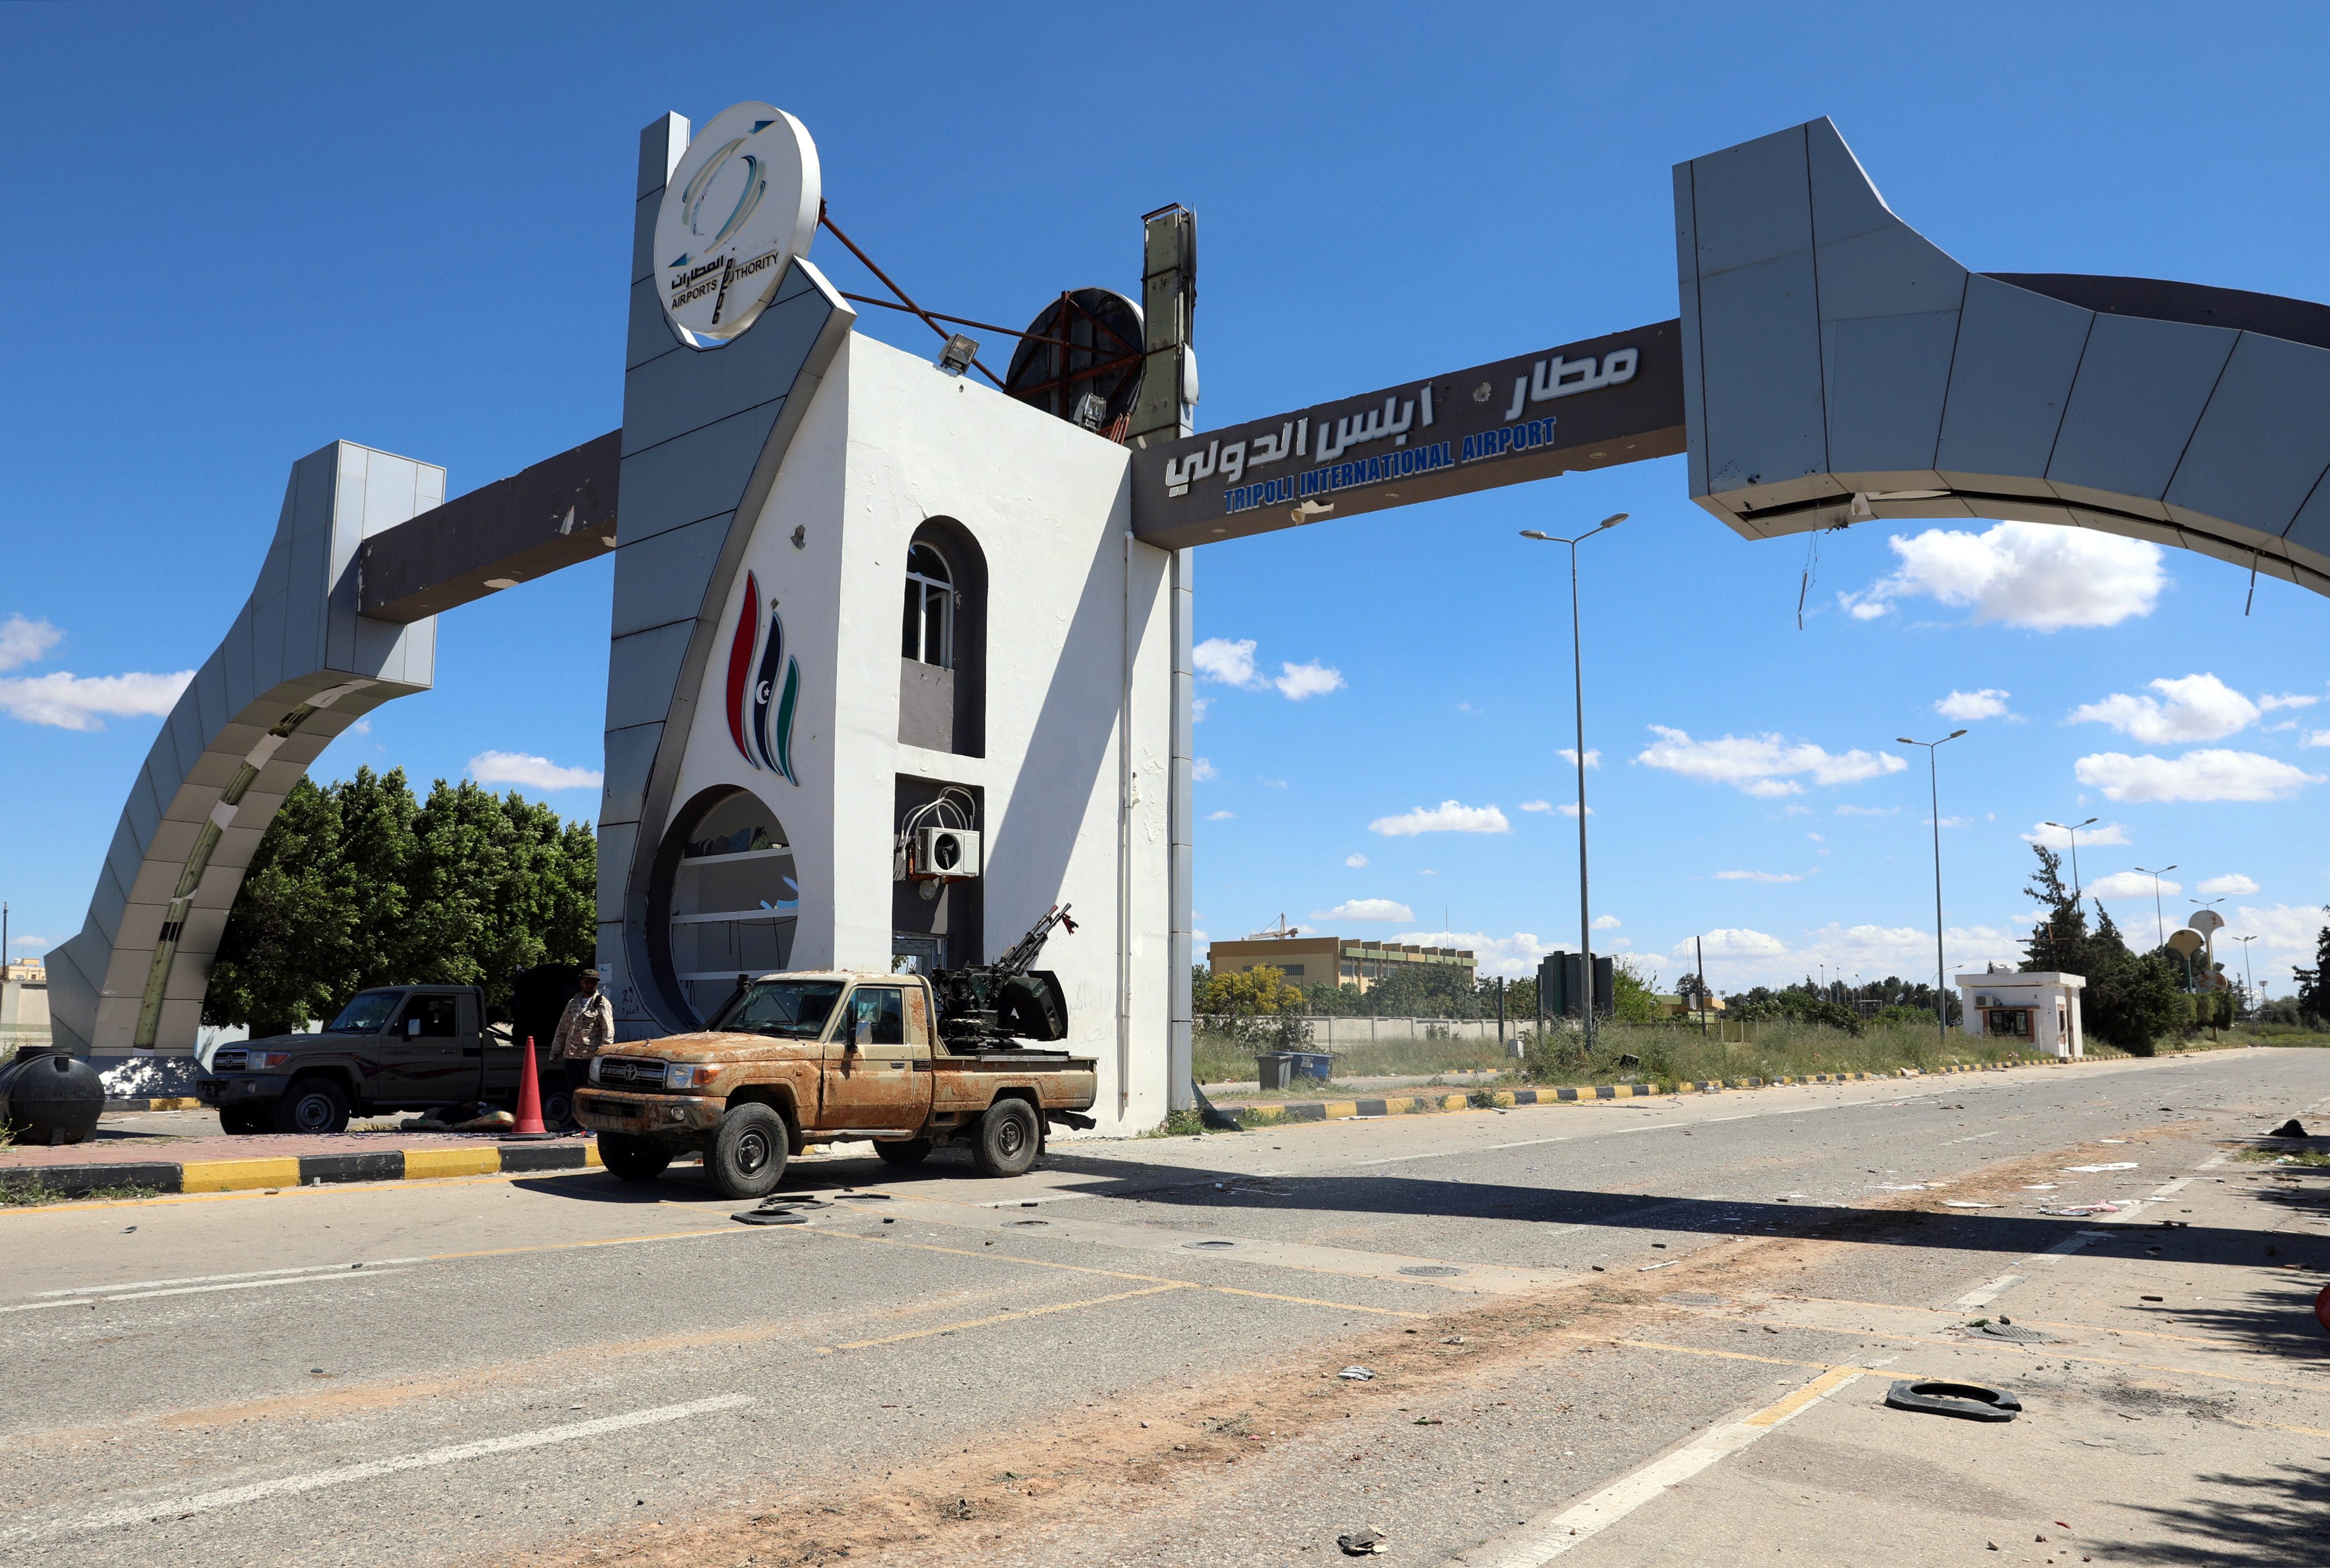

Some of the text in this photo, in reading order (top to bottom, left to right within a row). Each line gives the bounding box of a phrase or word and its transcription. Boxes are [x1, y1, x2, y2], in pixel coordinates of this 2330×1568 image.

[671, 251, 779, 310] AIRPORTS UTHORITY
[1505, 347, 1638, 422] مطار
[1166, 417, 1309, 497] الدولي
[1224, 416, 1557, 515] TRIPOLI INTERNATIONAL AIRPORT
